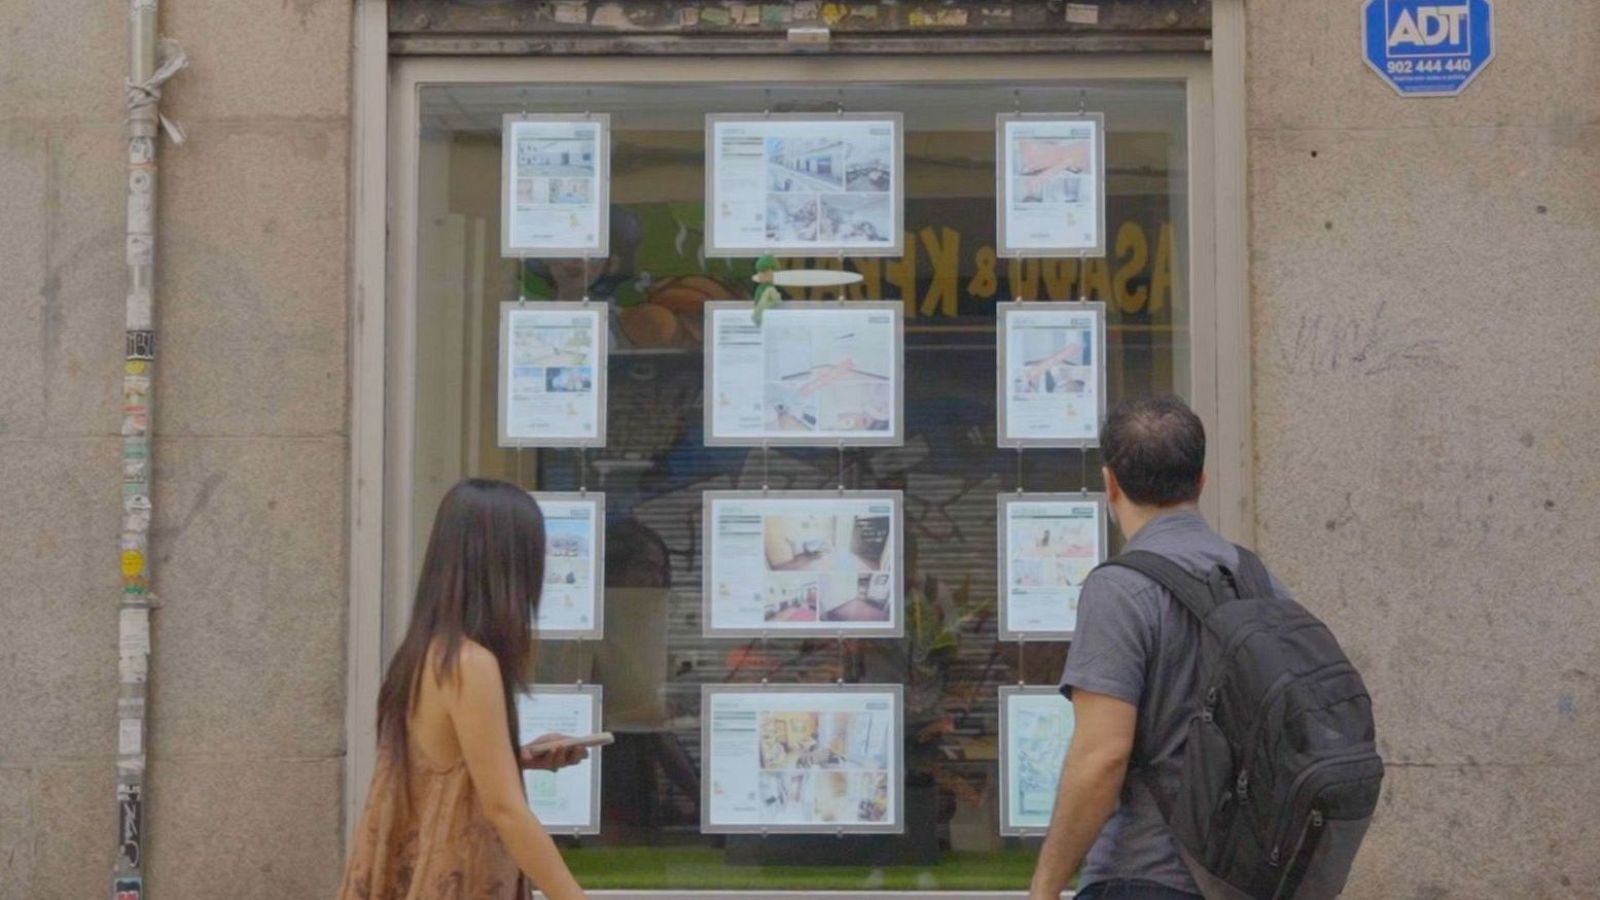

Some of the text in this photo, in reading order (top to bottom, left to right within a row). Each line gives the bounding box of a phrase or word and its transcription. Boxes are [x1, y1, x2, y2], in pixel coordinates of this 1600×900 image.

[1388, 5, 1468, 46] ADT
[1387, 59, 1472, 73] 902 444 440
